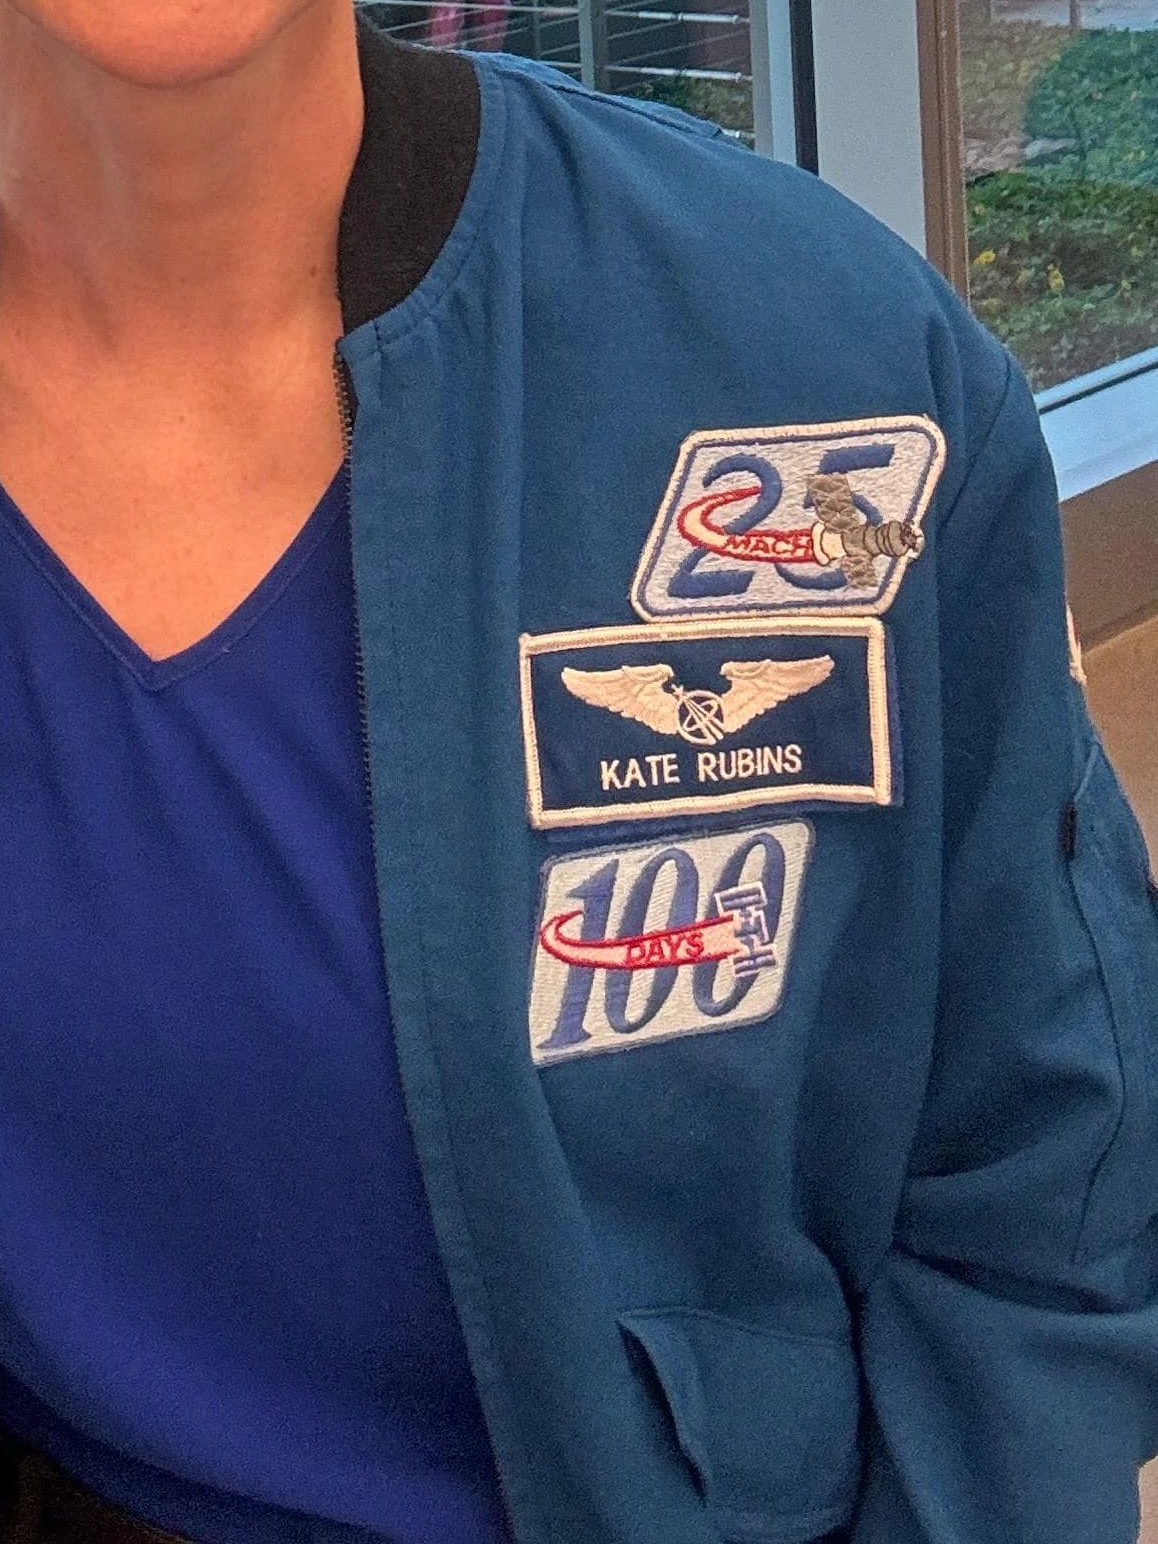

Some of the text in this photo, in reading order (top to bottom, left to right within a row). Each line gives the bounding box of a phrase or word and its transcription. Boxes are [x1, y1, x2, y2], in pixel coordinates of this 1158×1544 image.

[668, 444, 895, 597] 25
[723, 535, 812, 557] MACH
[600, 744, 802, 791] KATE RUBINS
[537, 833, 785, 1049] 100
[625, 931, 704, 966] DAYS
